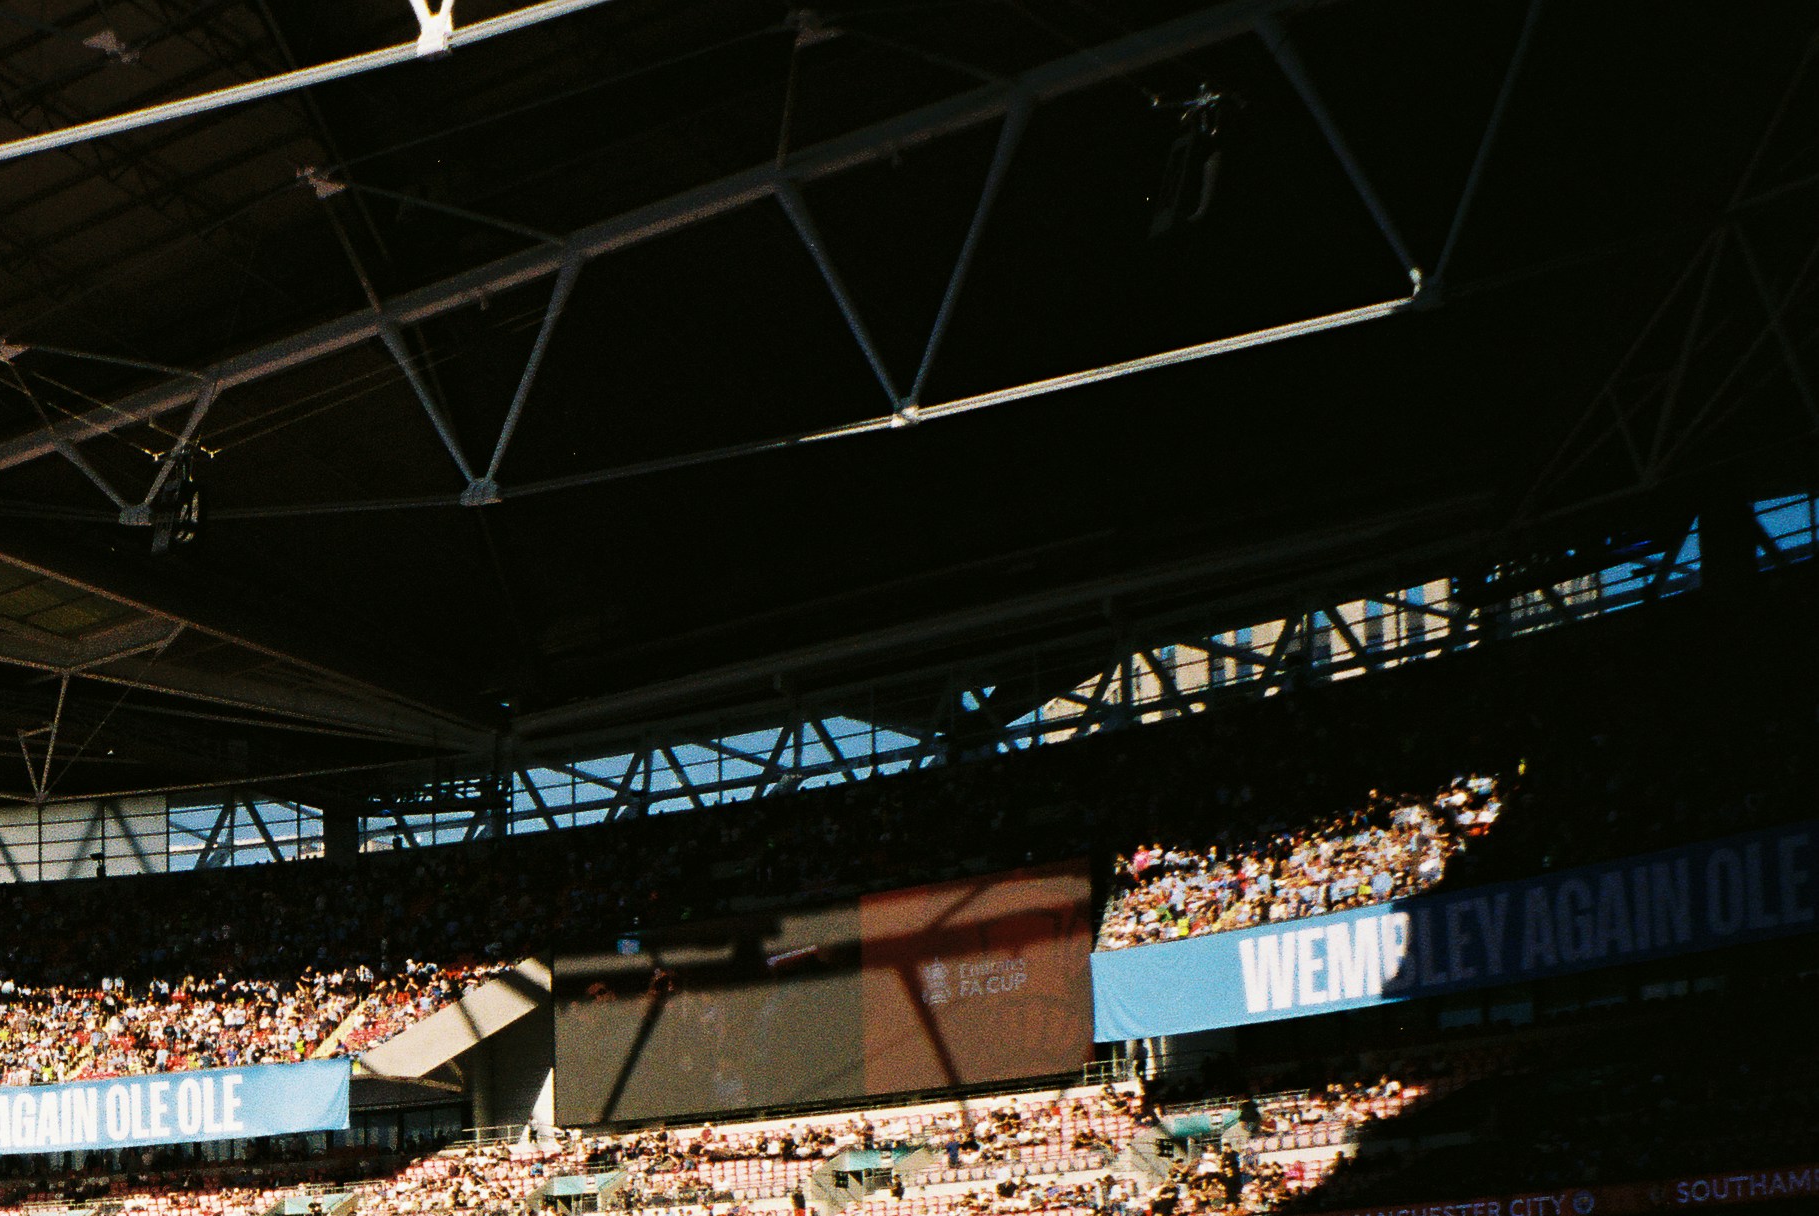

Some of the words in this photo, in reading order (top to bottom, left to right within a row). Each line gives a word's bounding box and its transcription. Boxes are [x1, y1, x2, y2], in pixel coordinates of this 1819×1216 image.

[1239, 891, 1511, 1014] WEMBLEY
[1520, 857, 1691, 974] AGAIN
[1705, 834, 1818, 936] OLE
[959, 980, 982, 997] FA
[986, 972, 1027, 994] CUP
[106, 1081, 170, 1142] OLE
[178, 1073, 244, 1134] OLE
